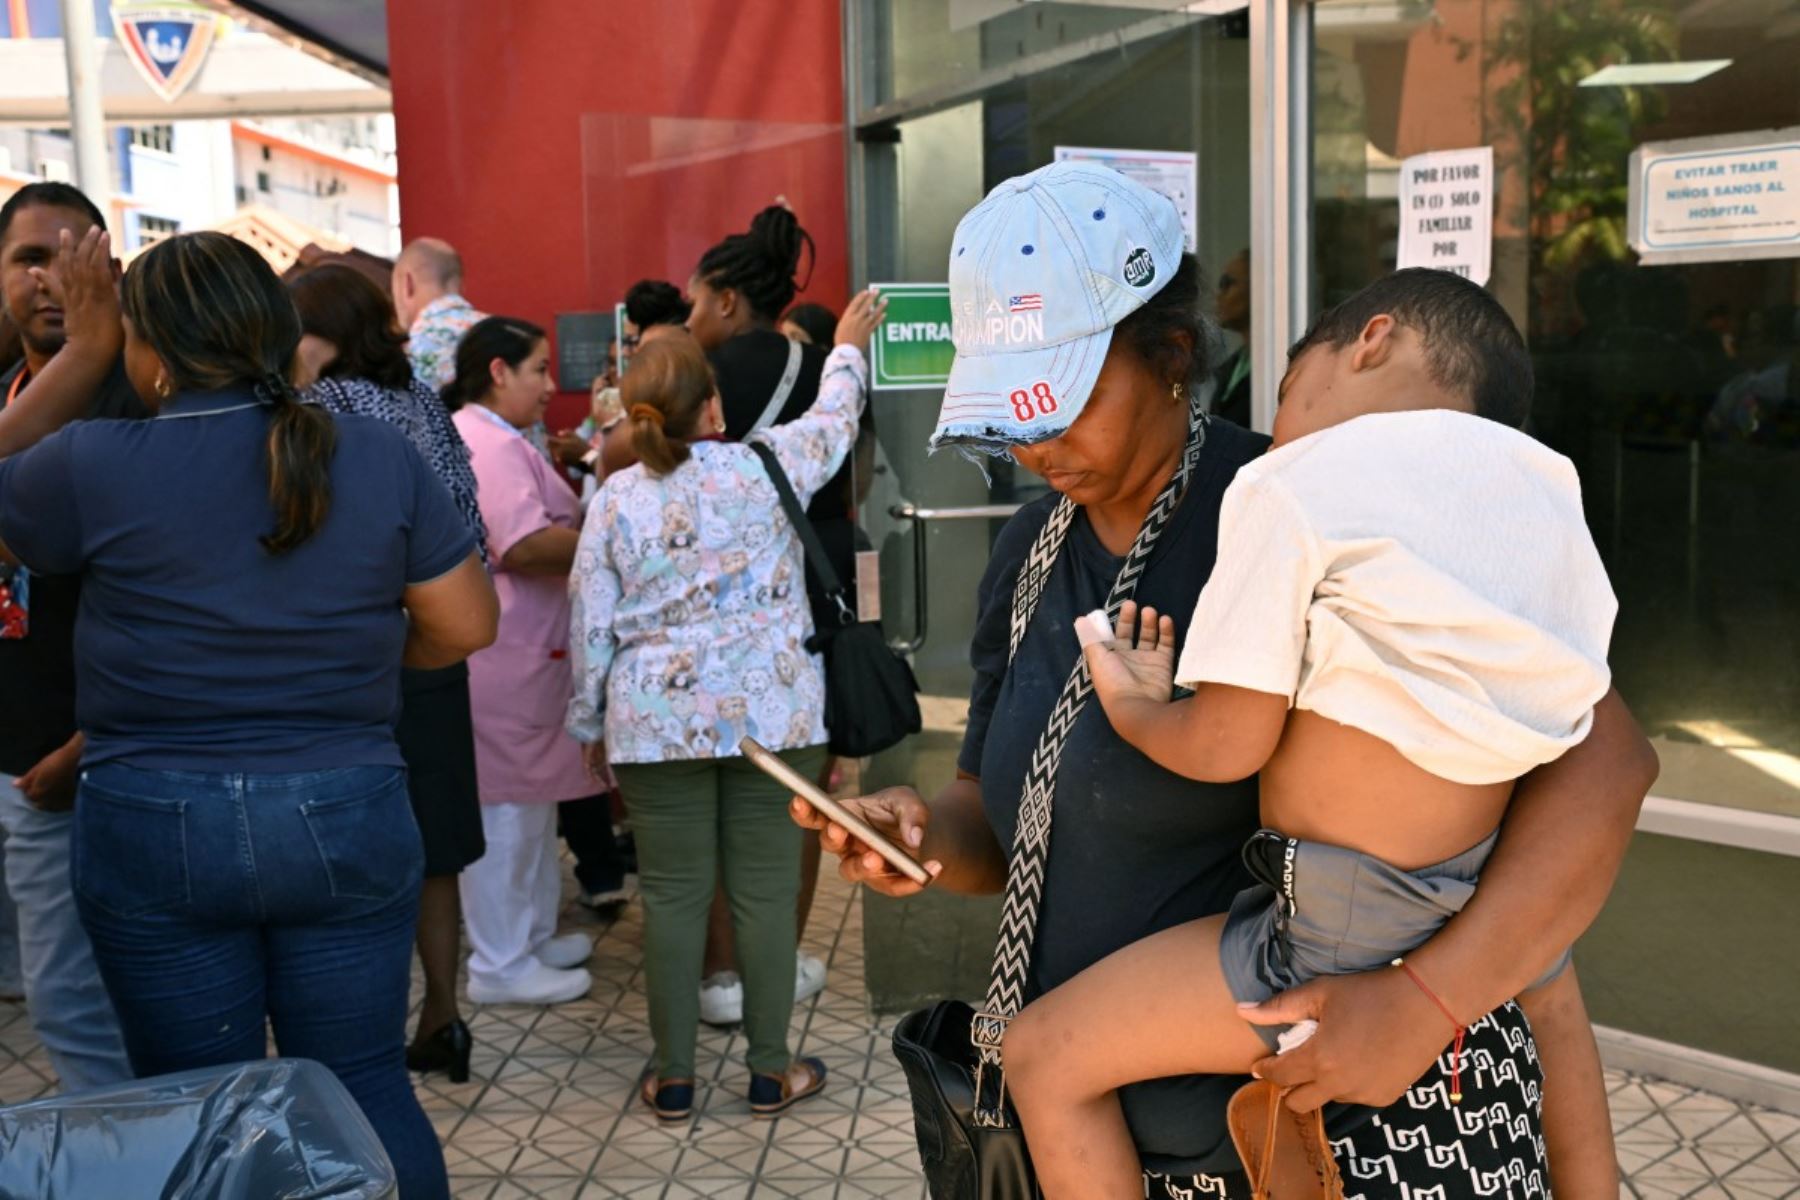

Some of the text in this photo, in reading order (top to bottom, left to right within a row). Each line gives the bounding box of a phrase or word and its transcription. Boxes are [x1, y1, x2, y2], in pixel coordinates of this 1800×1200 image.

[1413, 165, 1480, 184] POR FAVOR
[1674, 160, 1778, 180] EVITAR TRAER
[1450, 191, 1480, 207] SOLO
[1665, 180, 1785, 201] NIÑOS SANOS AL
[1688, 204, 1759, 219] HOSPITAL
[1419, 217, 1472, 234] FAMILIAR
[1433, 242, 1457, 257] POR
[986, 298, 1004, 314] A
[1008, 381, 1058, 423] 88
